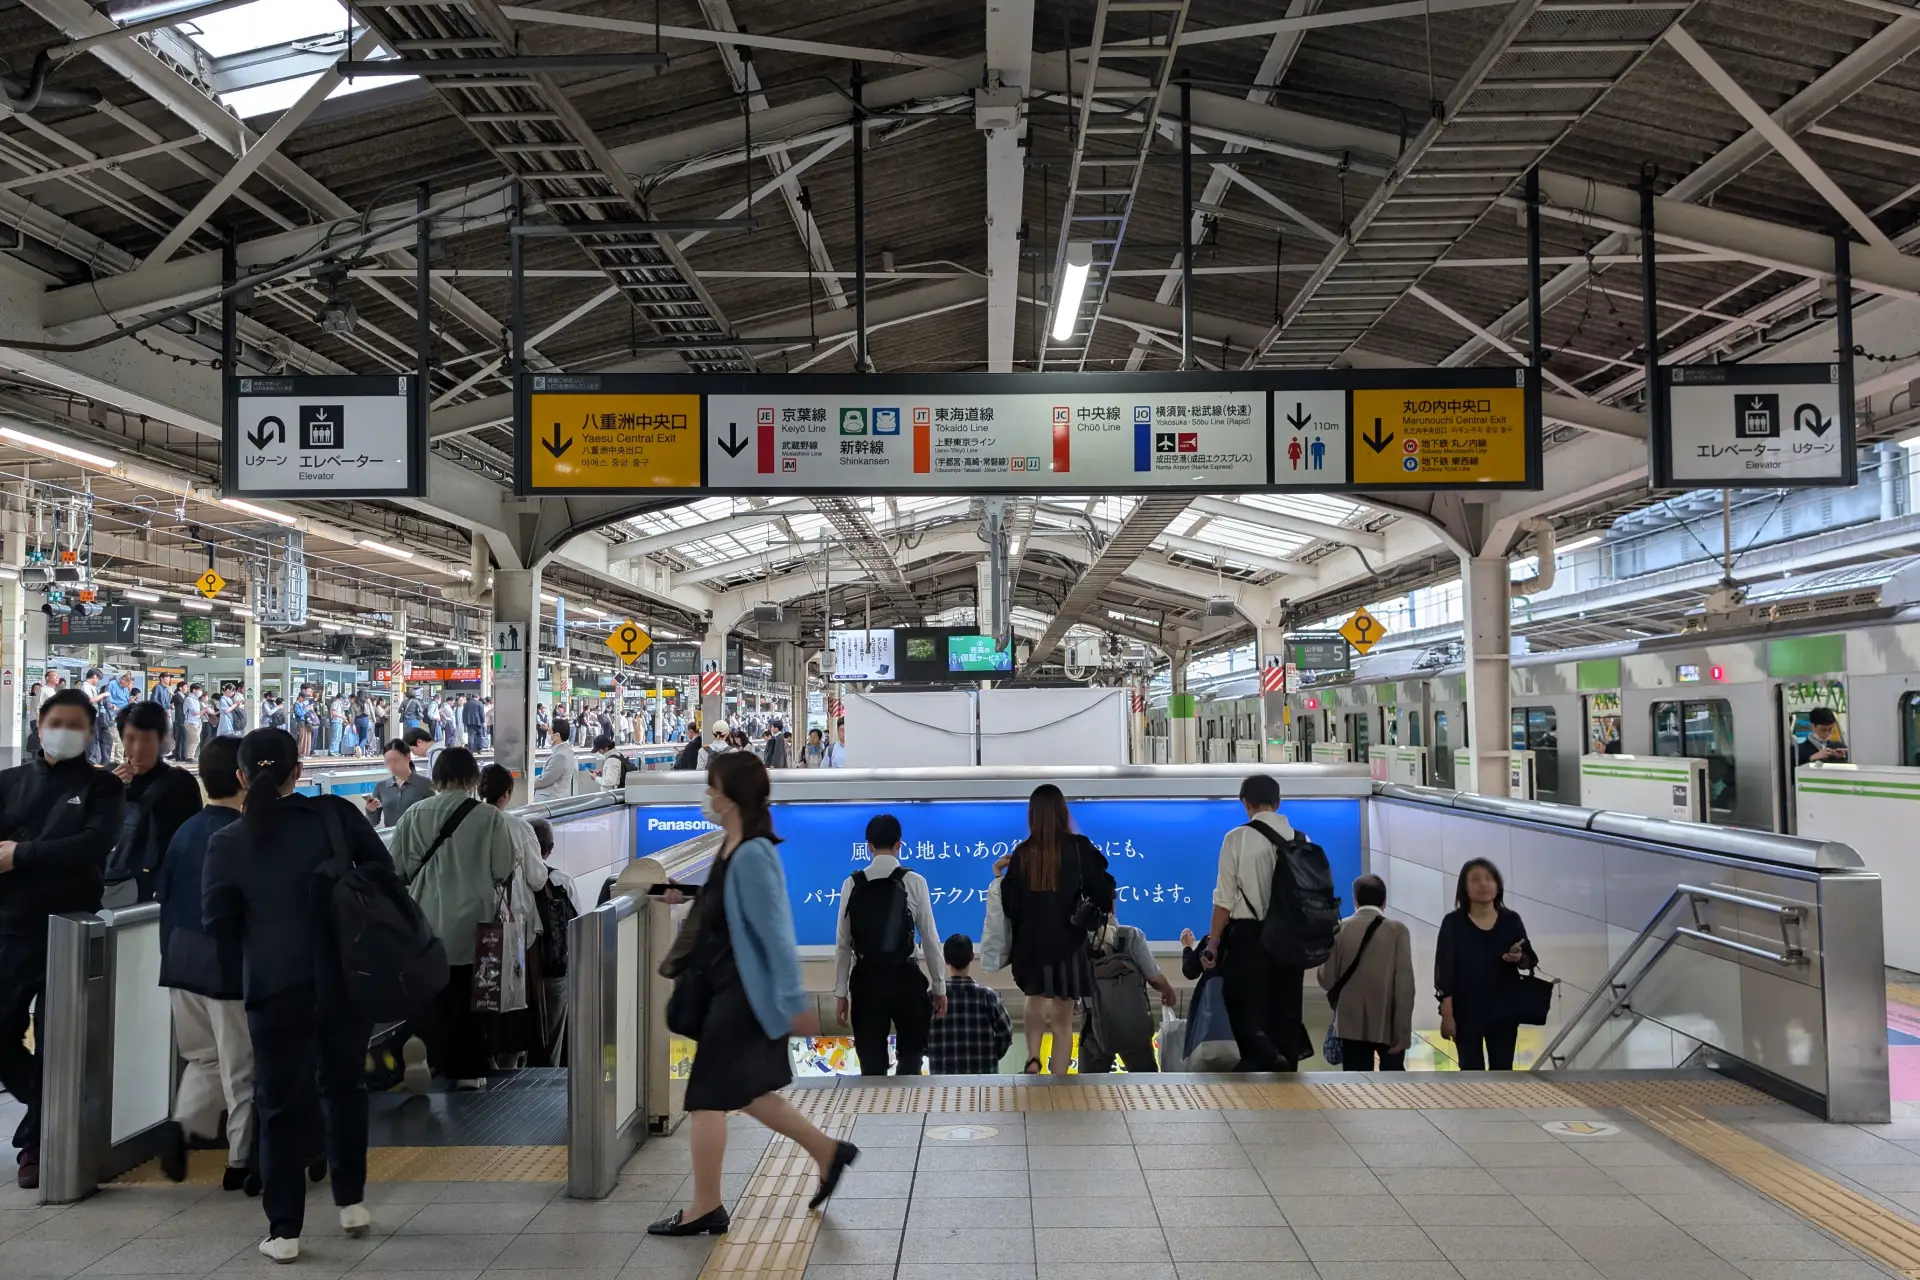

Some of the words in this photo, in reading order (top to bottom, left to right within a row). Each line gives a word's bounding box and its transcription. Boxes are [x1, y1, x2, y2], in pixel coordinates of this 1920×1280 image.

[1155, 405, 1252, 418] 横須賀・総武線(快速)
[1403, 399, 1491, 414] 丸の内中央口
[760, 412, 771, 421] JE
[781, 407, 827, 422] 京葉線
[916, 411, 927, 421] JT
[934, 406, 995, 422] 東海道線
[1055, 411, 1067, 420] JC
[1077, 406, 1121, 421] 中央線
[1136, 410, 1149, 419] JO
[581, 413, 688, 431] 八重洲中央口
[1226, 417, 1251, 427] (Rapid)
[1402, 416, 1454, 425] Marunouchi
[1456, 416, 1488, 425] Central
[1489, 415, 1507, 424] Exit
[808, 424, 827, 433] Line
[934, 423, 968, 433] Tōkaidō
[970, 423, 989, 433] Line
[1102, 423, 1121, 432] Line
[1313, 421, 1340, 431] 110m
[581, 433, 614, 443] Yaesu
[616, 433, 654, 443] Central
[657, 433, 677, 443] Exit
[934, 437, 996, 447] 上野東京ライン
[781, 440, 819, 450] 武蔵野線
[839, 440, 885, 455] 新幹線
[1421, 439, 1449, 449] 地下鉄
[1451, 439, 1487, 448] 丸ノ内線
[1792, 442, 1835, 454] Uターン
[581, 446, 643, 455] 八重洲中央出口
[1697, 443, 1781, 458] エレベーター
[245, 455, 288, 467] Uターン
[299, 454, 384, 468] エレベーター
[581, 458, 608, 467] 야에스
[839, 456, 890, 466] Shinkansen
[1156, 453, 1253, 464] 成田空港(成田エクスプレス)
[1421, 456, 1449, 466] 地下鉄
[1451, 456, 1479, 466] 東西線
[783, 461, 795, 469] JM
[1013, 460, 1023, 468] JU
[1028, 460, 1037, 468] JJ
[1745, 460, 1782, 469] Elevator
[298, 471, 335, 481] Elevator
[121, 617, 132, 632] 7
[1333, 645, 1344, 662] 5
[656, 651, 667, 667] 6
[378, 671, 384, 680] 8
[648, 818, 723, 831] Panason
